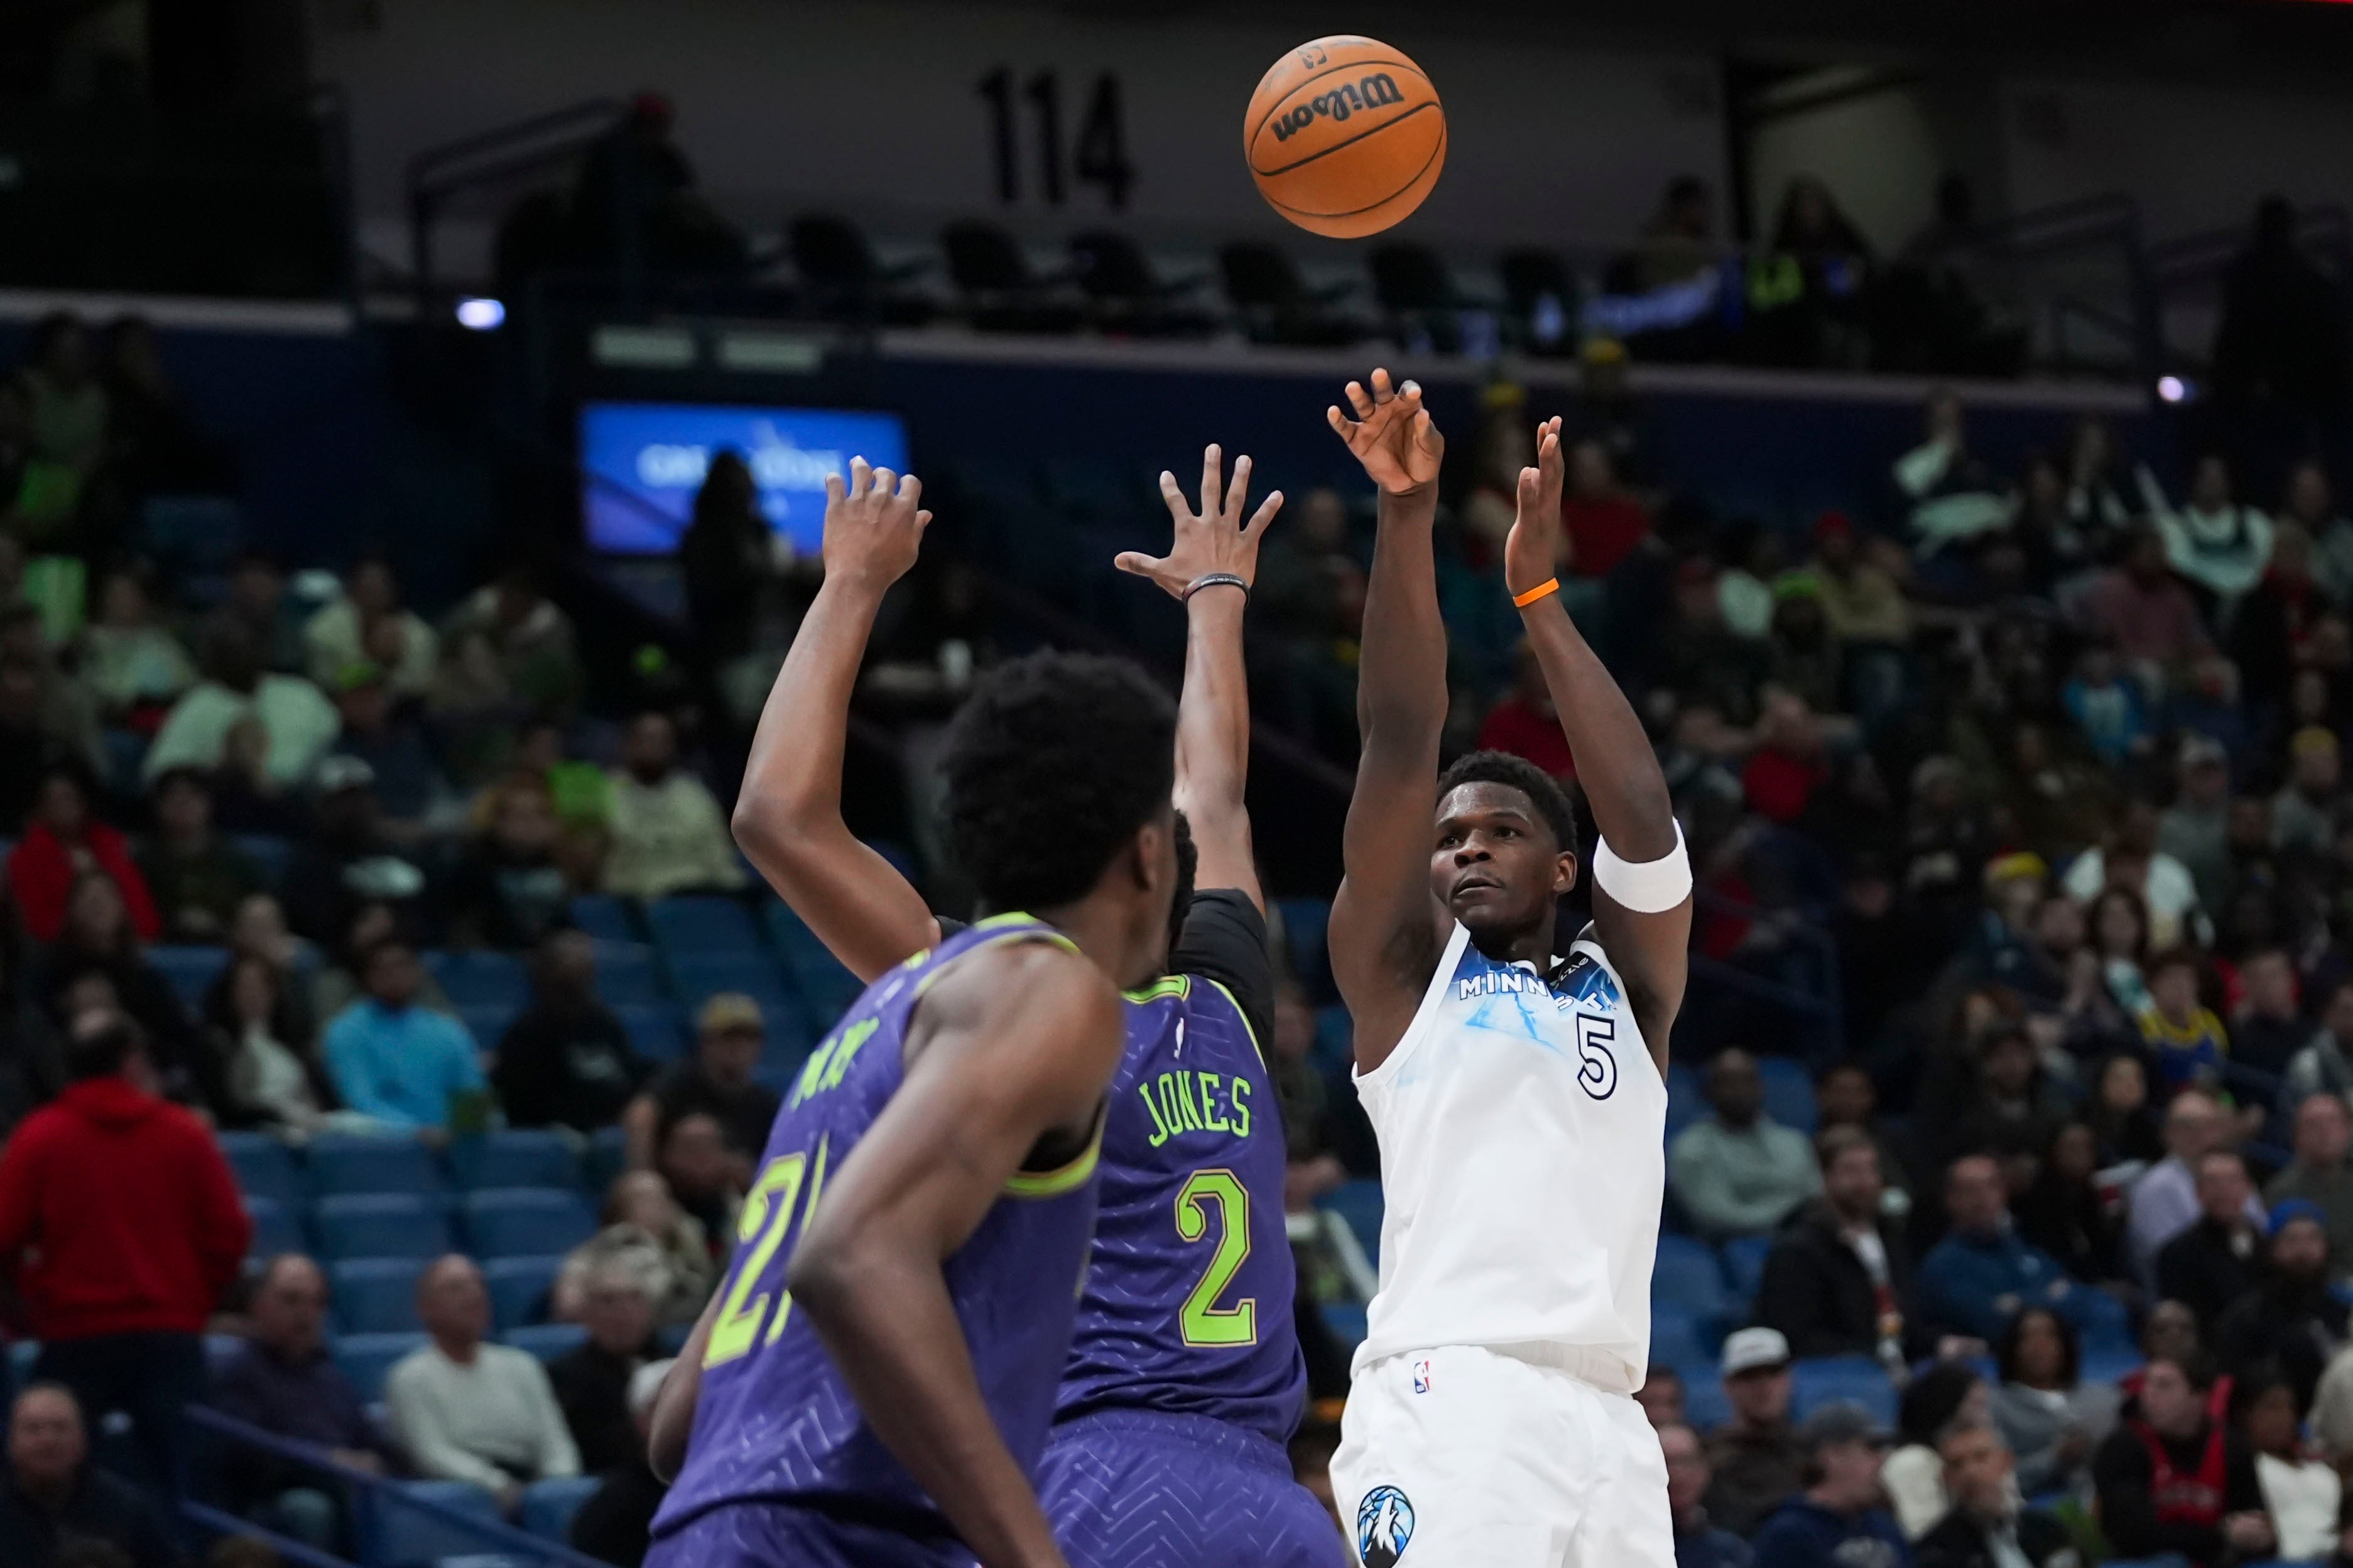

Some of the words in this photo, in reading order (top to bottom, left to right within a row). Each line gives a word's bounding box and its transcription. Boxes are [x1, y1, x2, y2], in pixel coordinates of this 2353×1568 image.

[977, 70, 1134, 208] 114
[1271, 72, 1405, 142] Wilson
[1577, 1011, 1617, 1100] 5
[1138, 1069, 1251, 1147] JONES
[1174, 1167, 1258, 1348] 2
